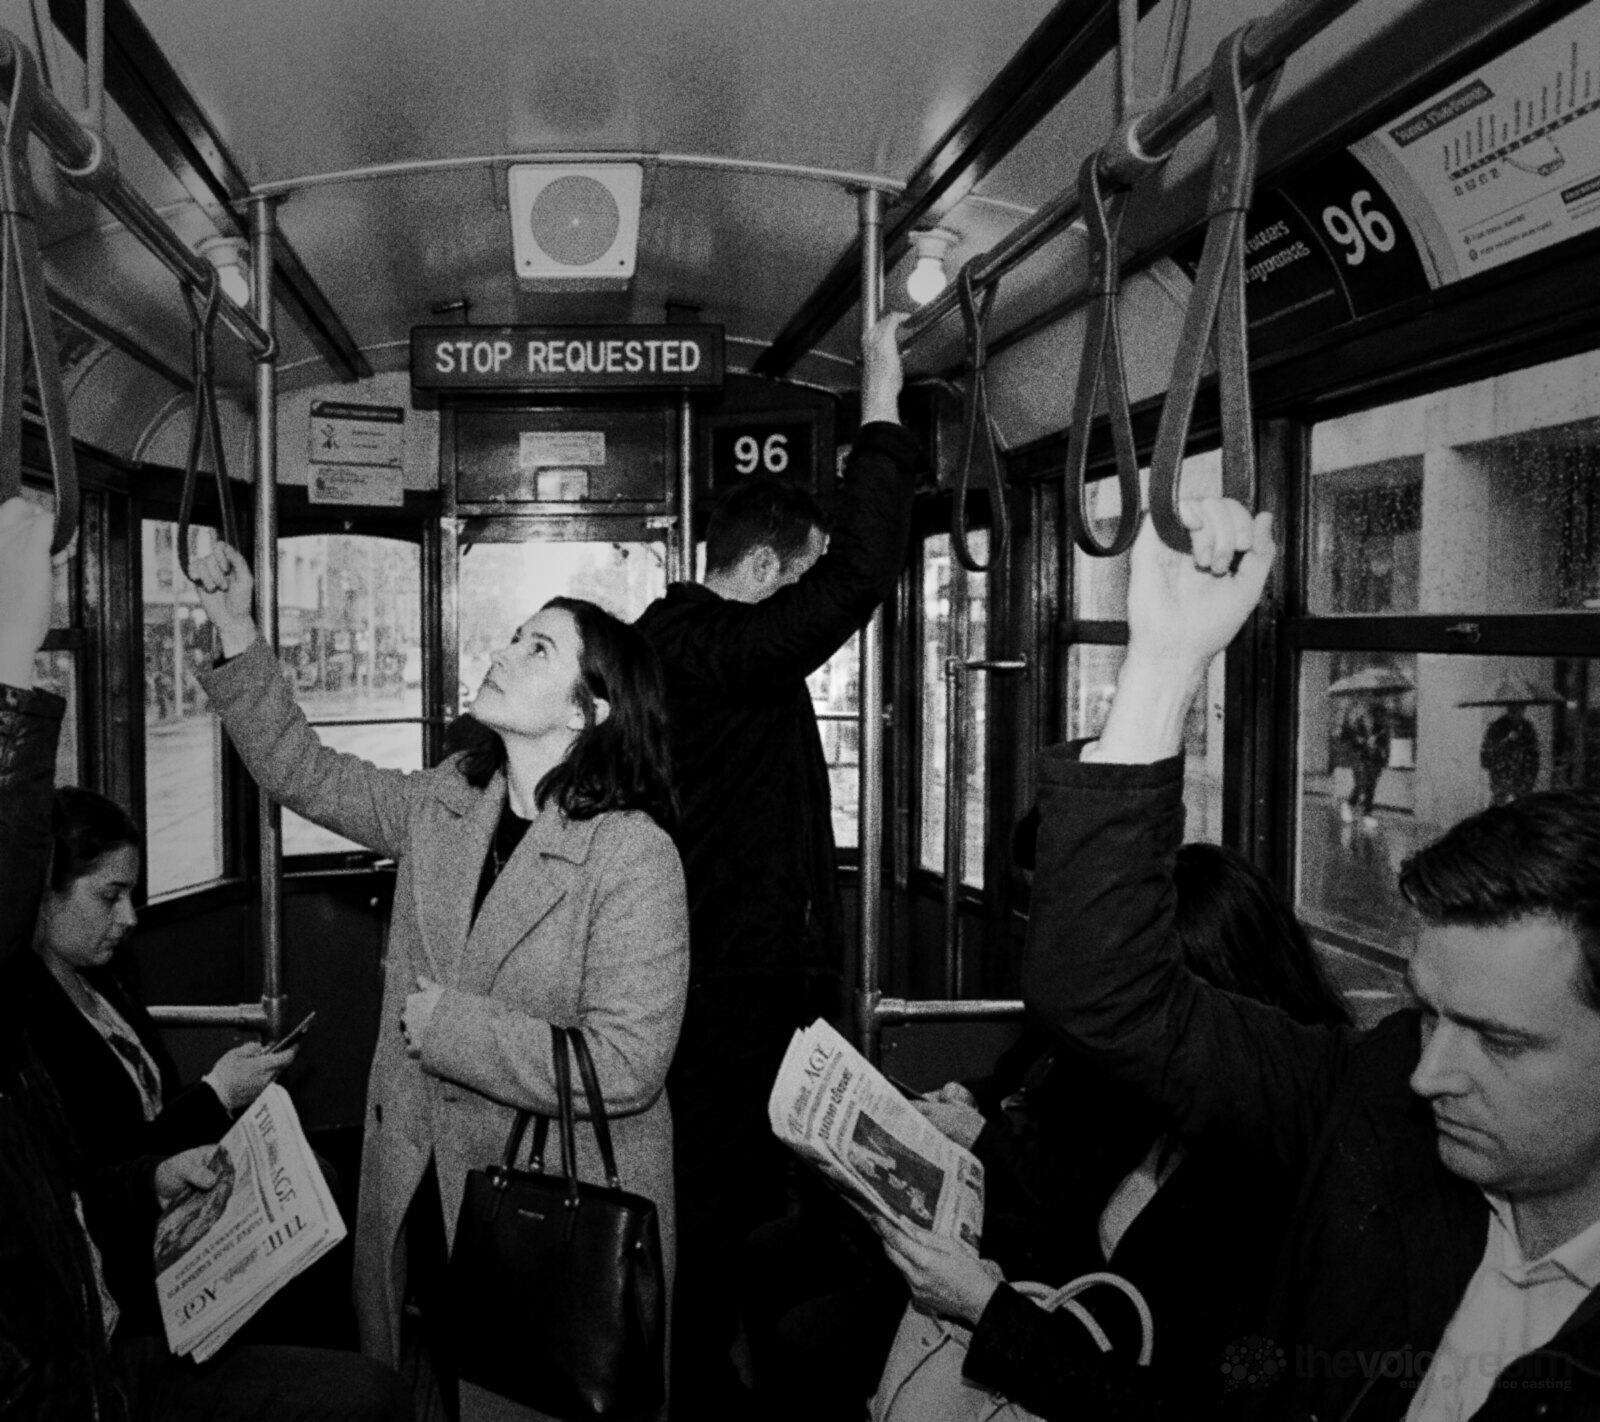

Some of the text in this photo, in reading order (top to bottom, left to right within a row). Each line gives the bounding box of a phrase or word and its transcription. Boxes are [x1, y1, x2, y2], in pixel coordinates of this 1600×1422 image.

[1322, 190, 1396, 266] 96
[435, 341, 701, 373] STOP REQUESTED
[734, 433, 789, 474] 96
